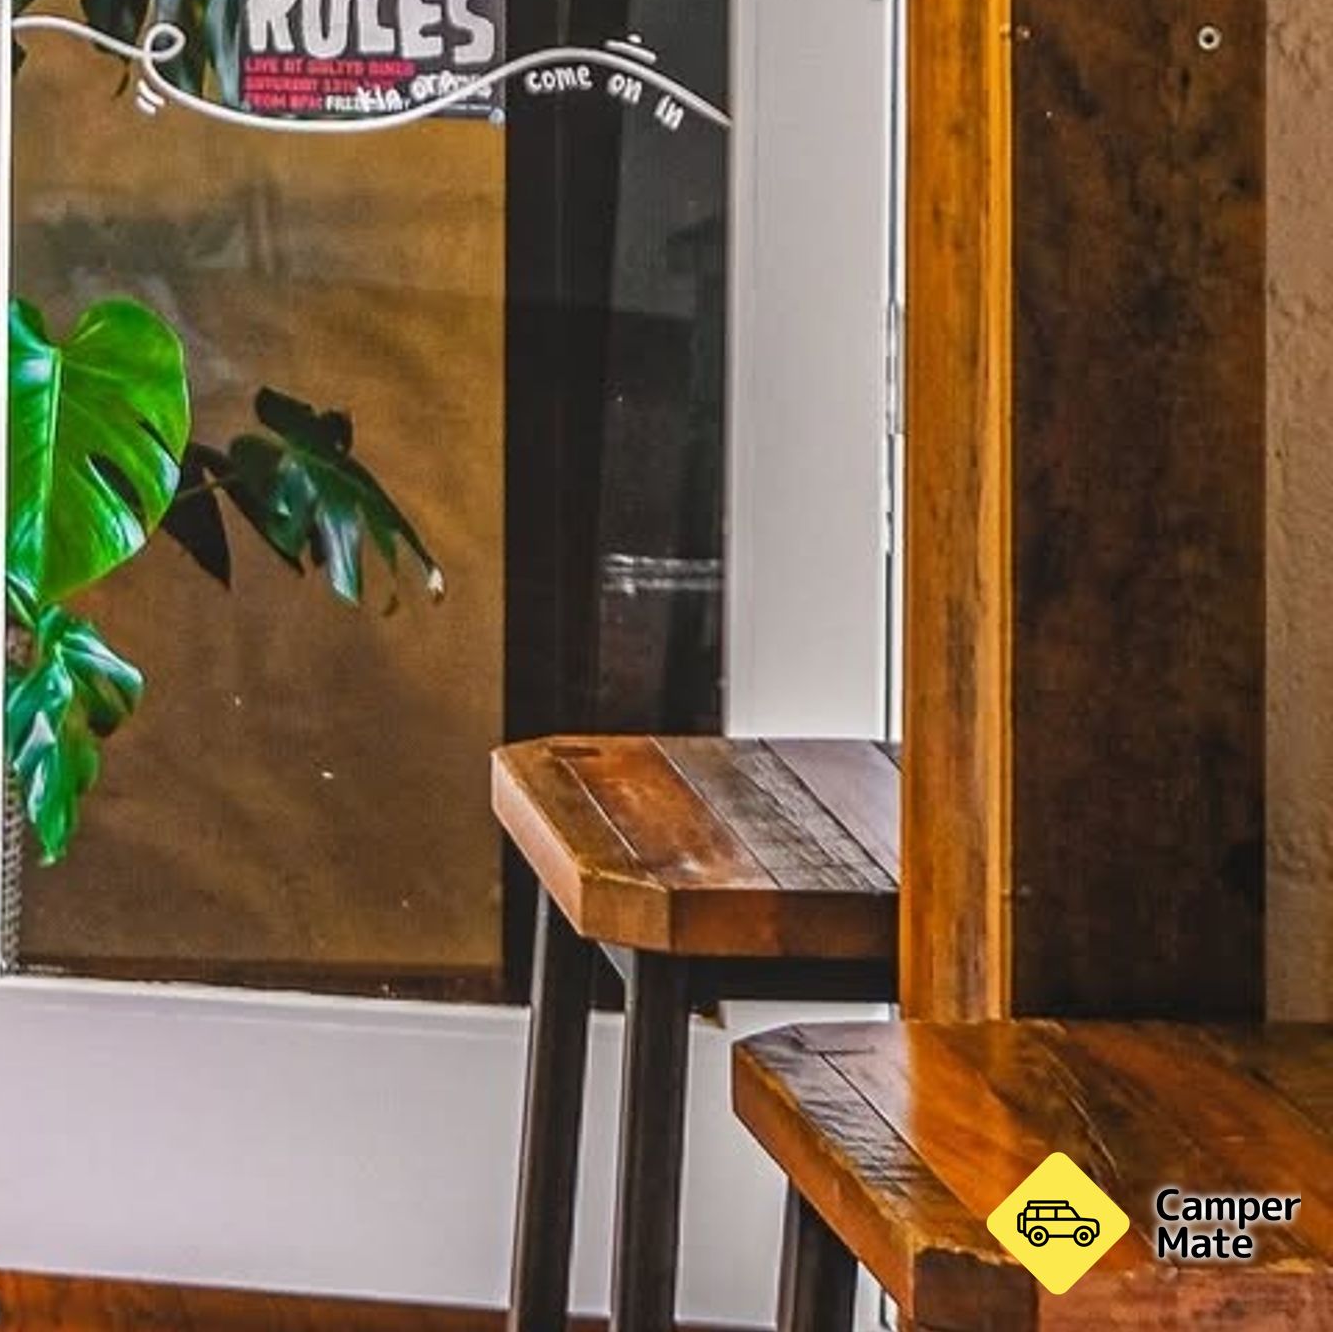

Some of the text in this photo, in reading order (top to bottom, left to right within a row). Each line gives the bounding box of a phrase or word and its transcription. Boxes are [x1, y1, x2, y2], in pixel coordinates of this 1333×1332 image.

[525, 65, 684, 131] come on in
